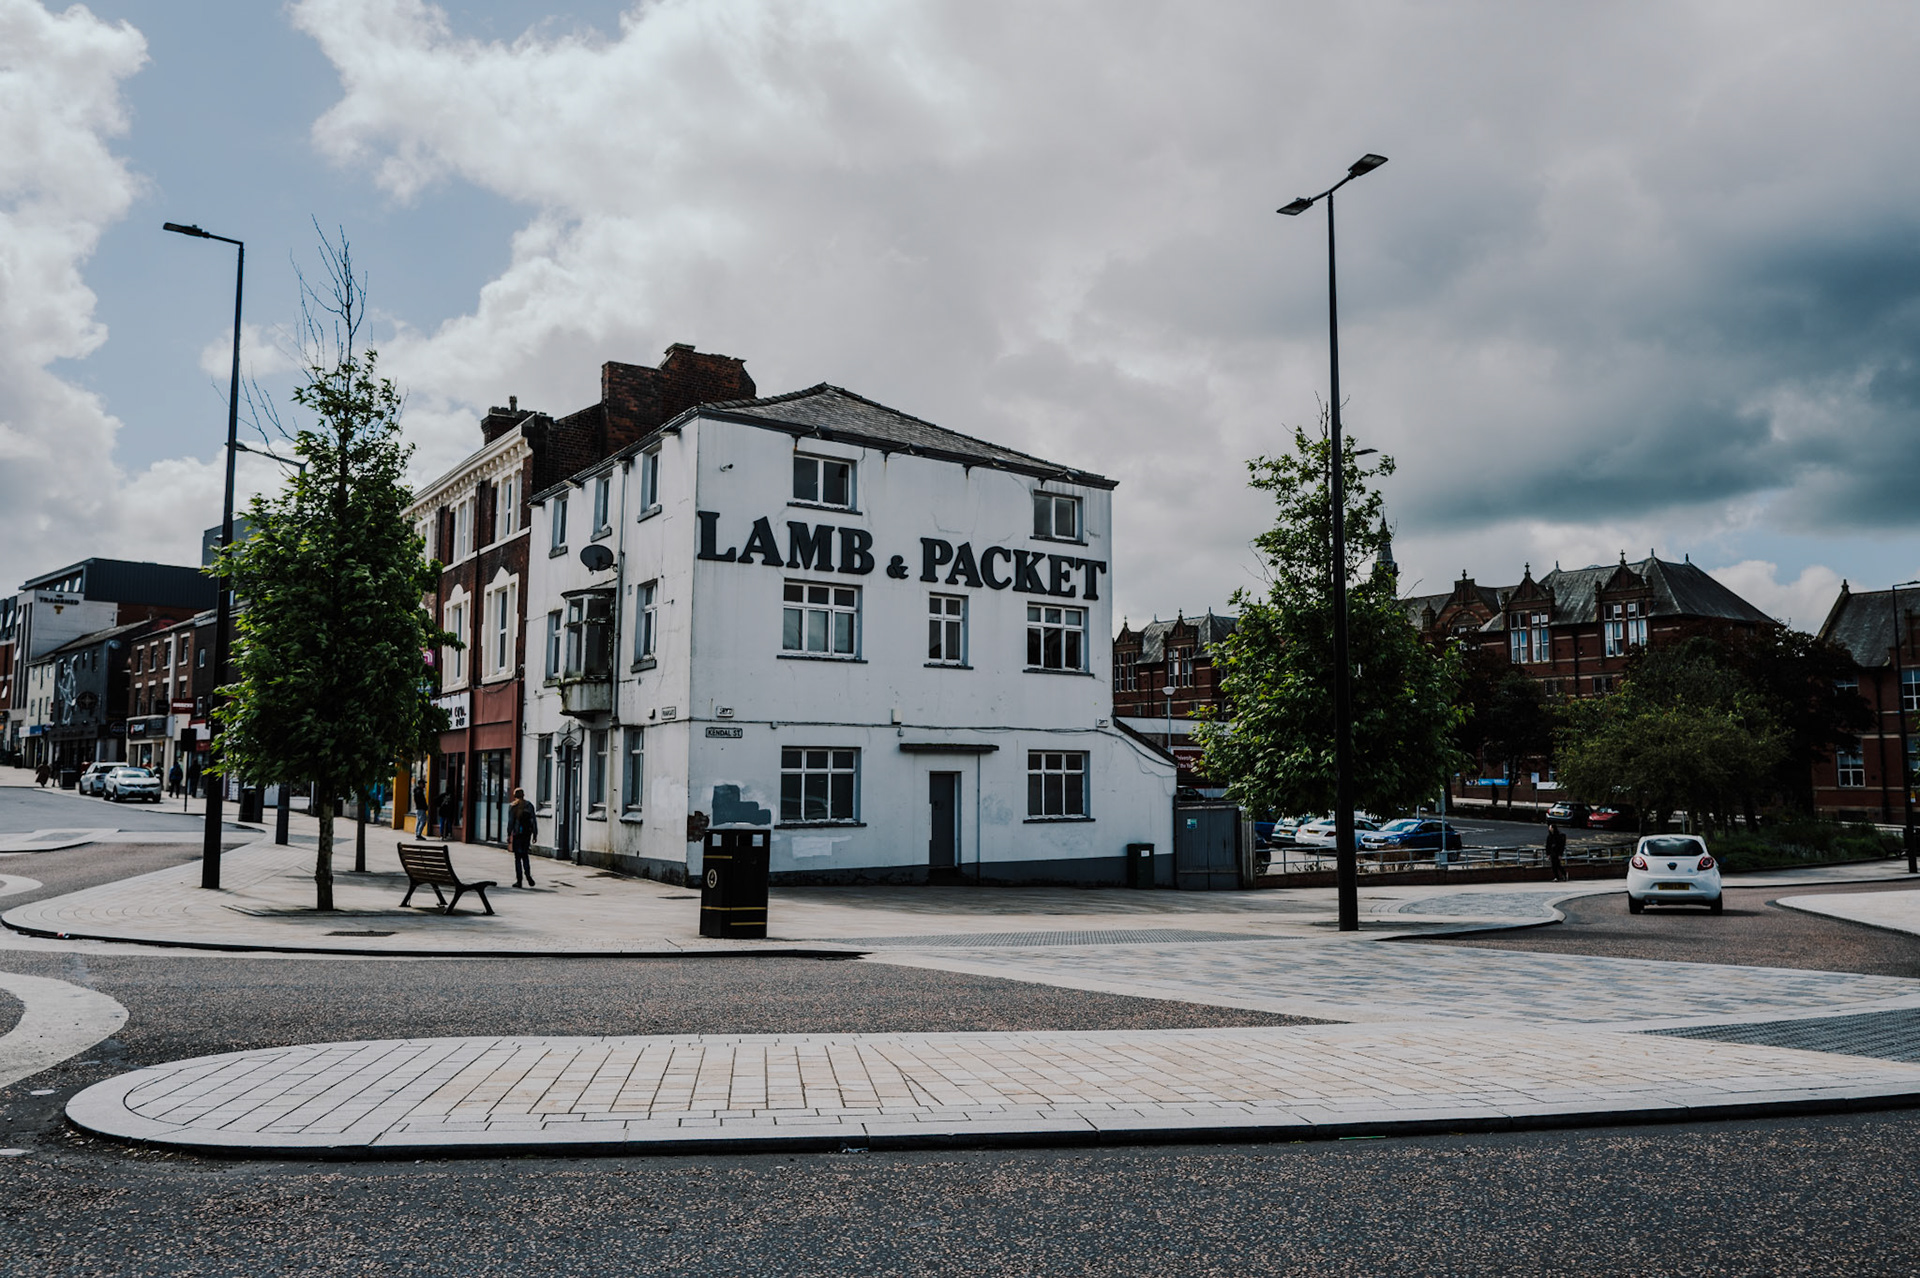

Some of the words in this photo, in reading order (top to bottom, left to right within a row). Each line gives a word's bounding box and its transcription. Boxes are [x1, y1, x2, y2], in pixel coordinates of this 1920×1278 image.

[697, 510, 875, 575] LAMB
[886, 554, 909, 580] &
[919, 536, 1107, 600] PACKET
[39, 597, 80, 606] TRAMSHED
[708, 729, 731, 737] KENDAL
[733, 729, 741, 737] ST
